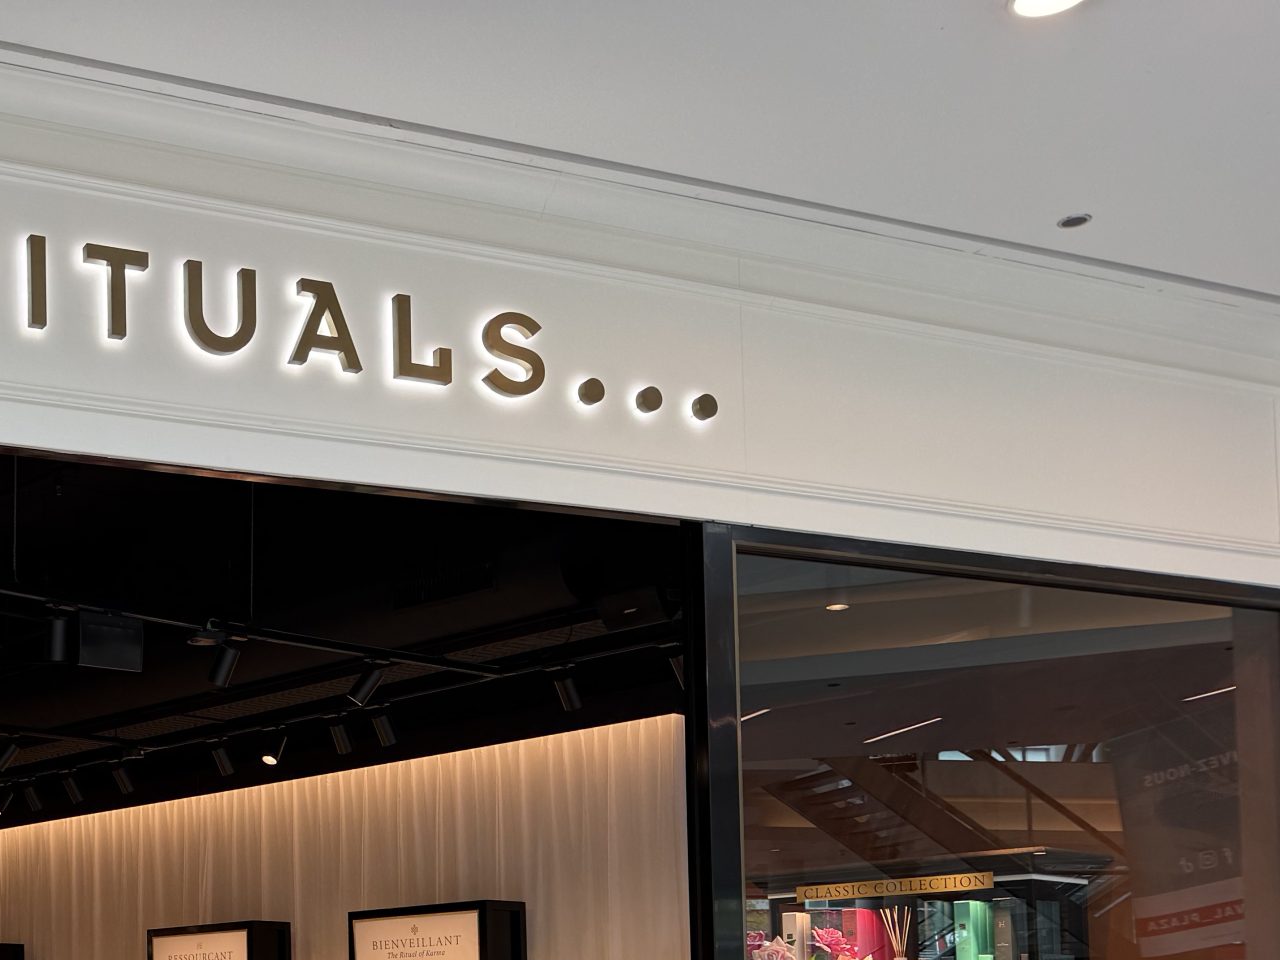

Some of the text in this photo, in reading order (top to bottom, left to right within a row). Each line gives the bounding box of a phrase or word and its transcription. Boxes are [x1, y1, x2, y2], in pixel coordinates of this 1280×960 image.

[804, 874, 986, 899] CLASSIC COLLECTION
[372, 935, 461, 950] BIENVEILLANT
